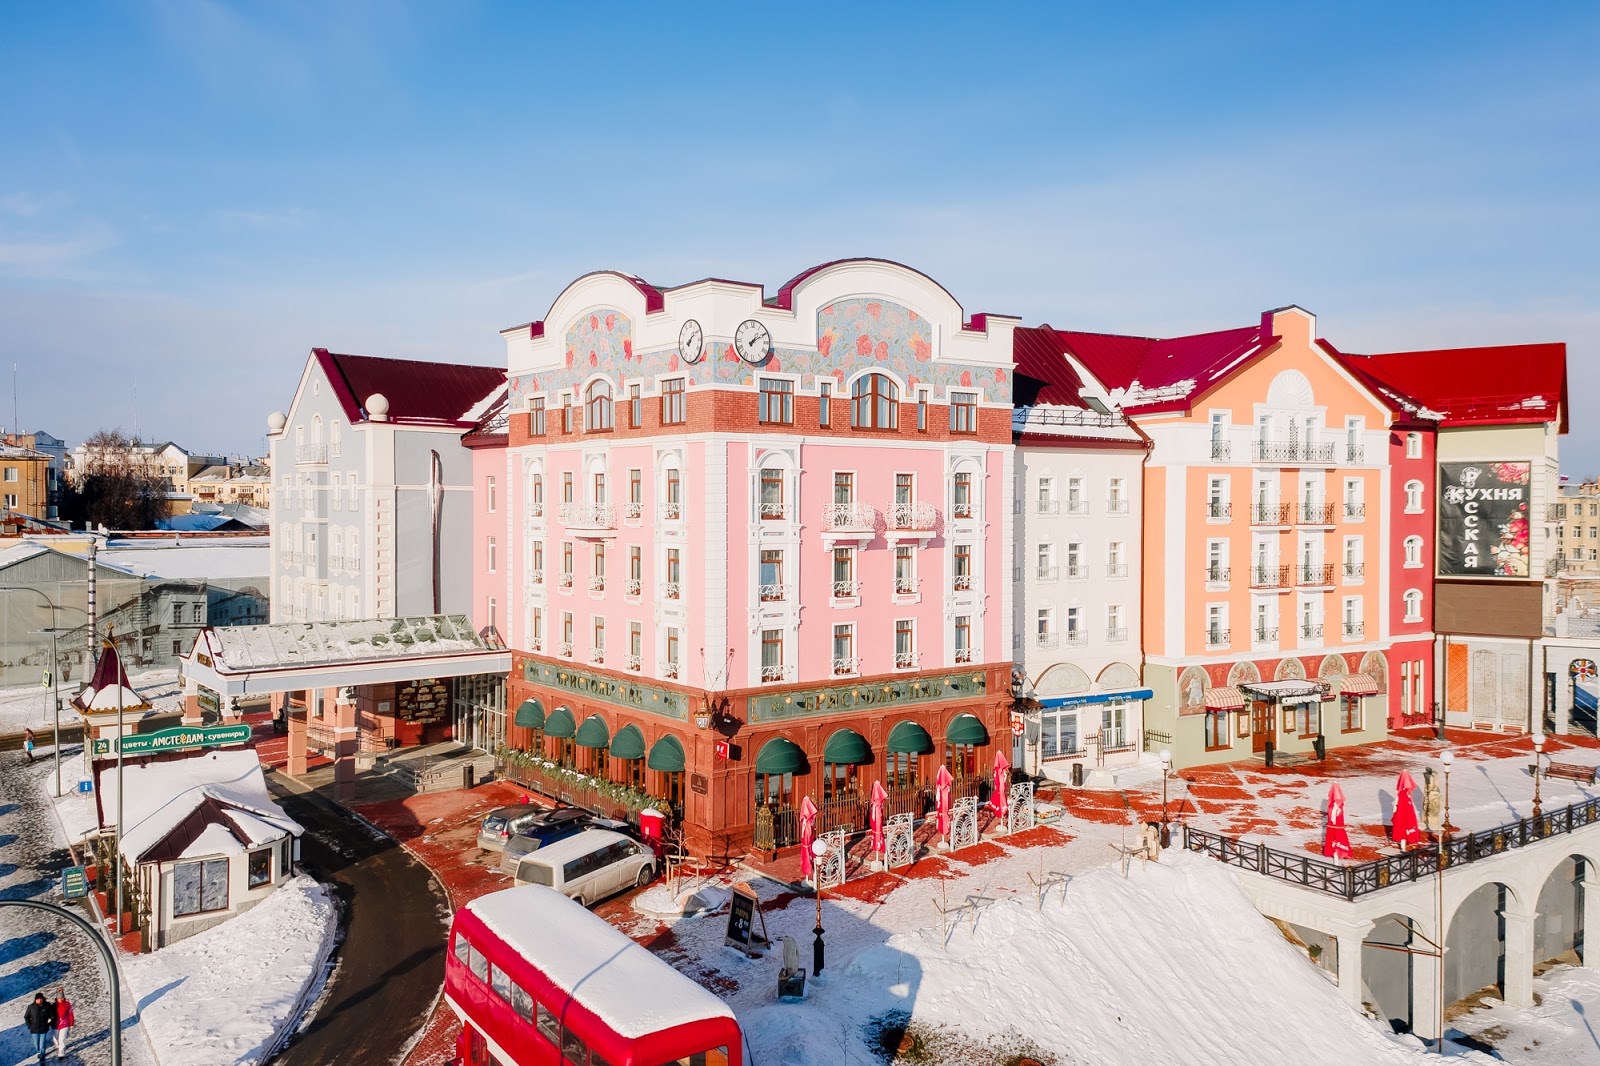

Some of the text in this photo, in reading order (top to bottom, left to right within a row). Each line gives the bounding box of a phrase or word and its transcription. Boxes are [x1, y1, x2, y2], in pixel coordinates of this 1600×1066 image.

[1446, 486, 1522, 502] КУХНЯ
[1461, 467, 1481, 568] РУССКАЯ
[805, 688, 898, 711] БРИСТОЛЬ
[909, 682, 942, 700] ПАБ
[122, 741, 148, 749] цветы
[207, 731, 245, 741] сувениры
